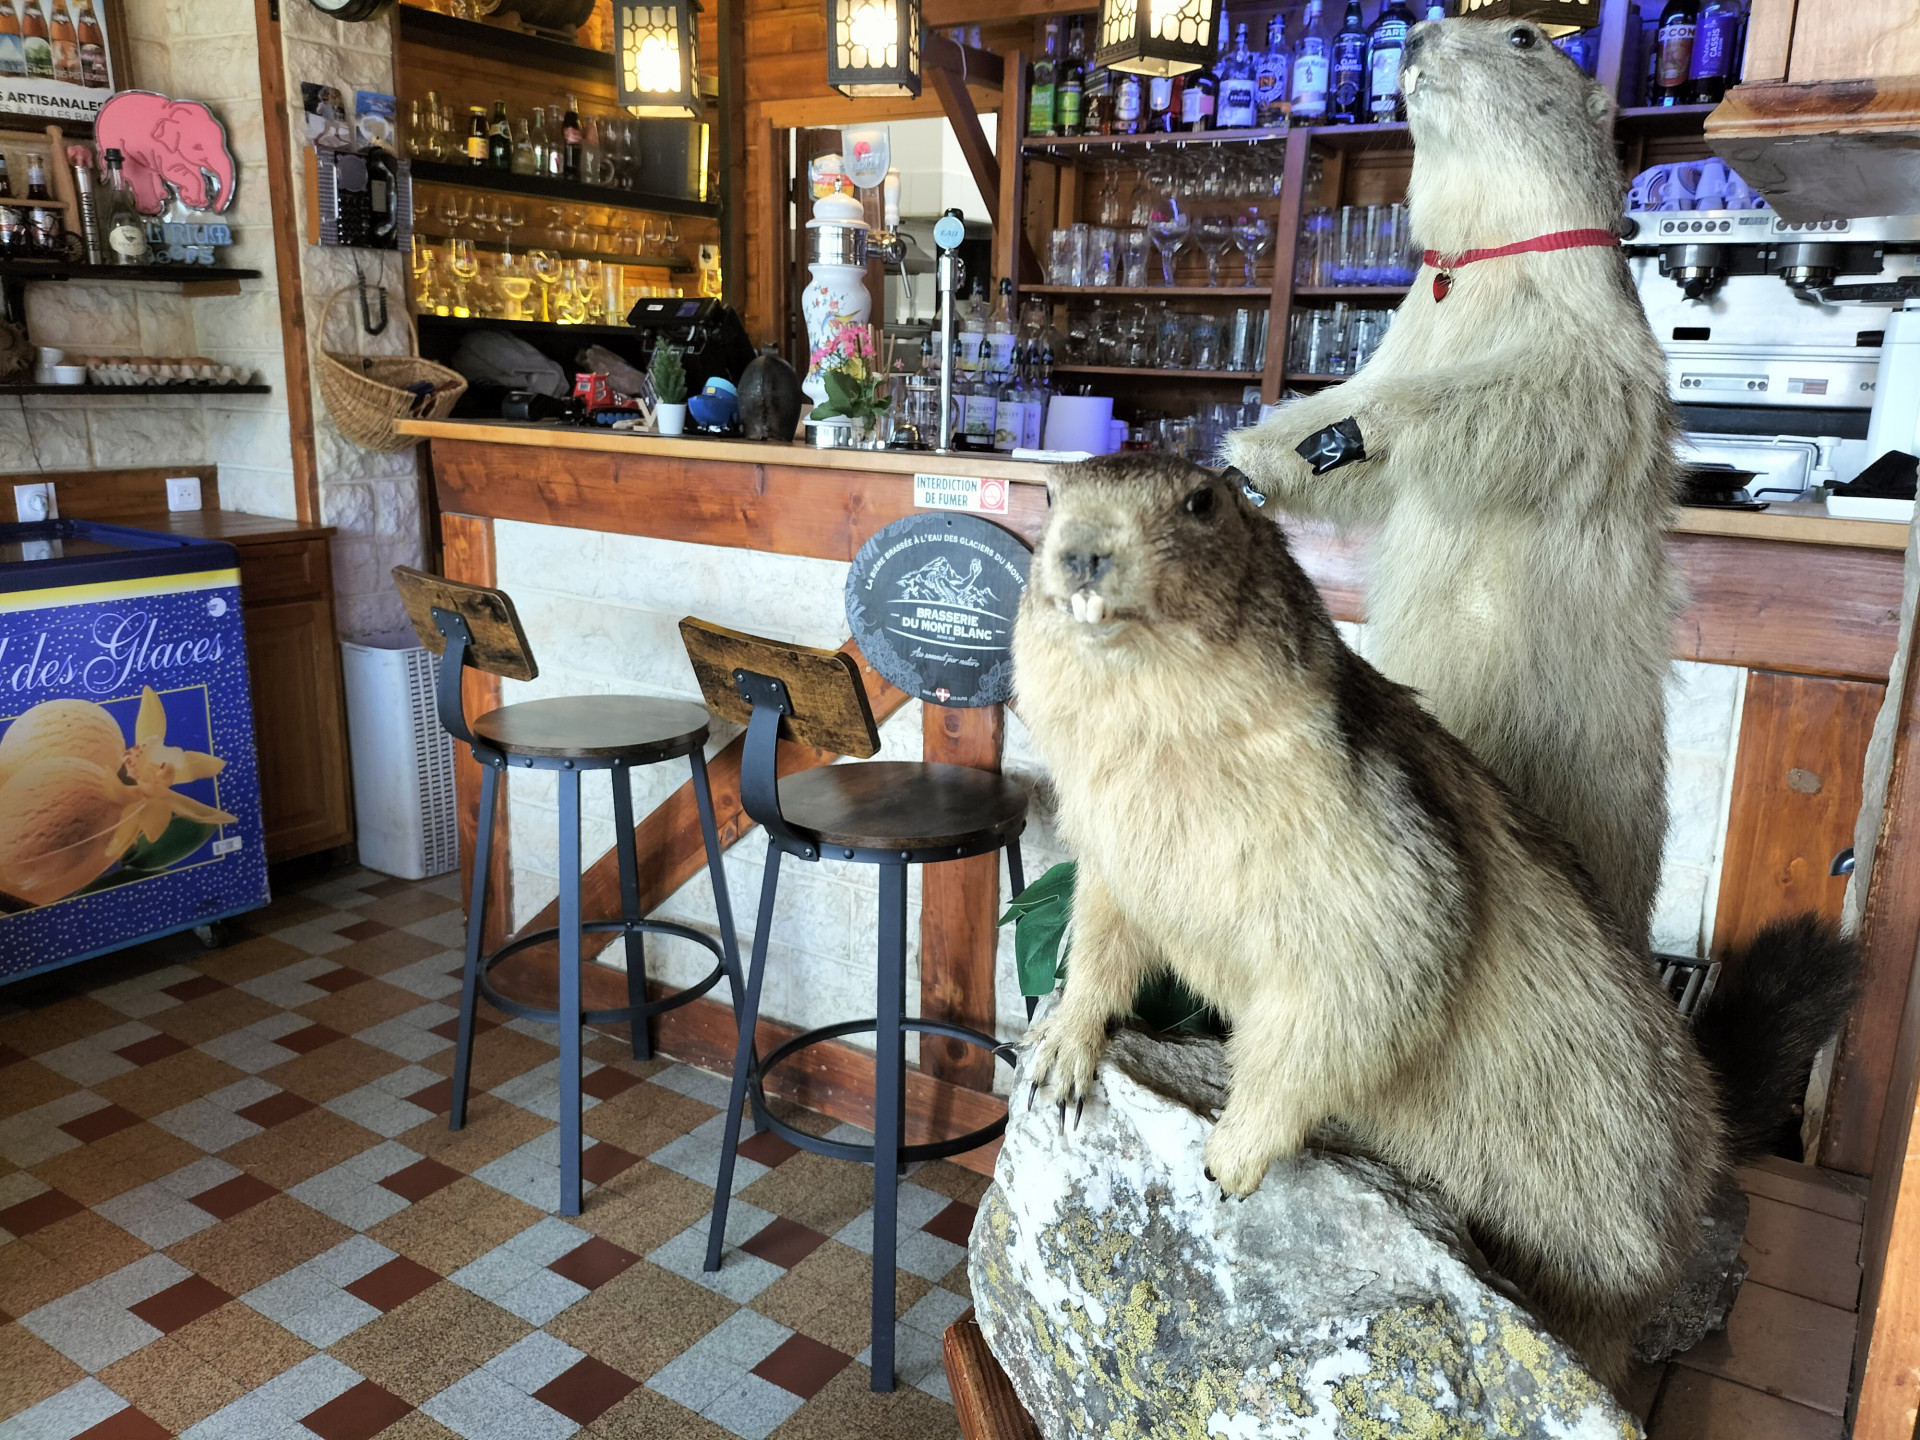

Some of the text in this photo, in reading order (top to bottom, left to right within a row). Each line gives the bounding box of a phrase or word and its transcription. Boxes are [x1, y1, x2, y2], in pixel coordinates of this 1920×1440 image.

[1374, 28, 1406, 39] RICARD
[1660, 27, 1696, 39] PCON
[1709, 28, 1720, 57] CASSIS
[8, 91, 105, 112] ARTISANALES
[940, 229, 958, 237] EAU
[917, 476, 978, 492] INTERDICTION
[925, 491, 968, 507] DE FUMER
[865, 533, 1025, 590] LA BIÈRE BRASSÉE À L'EAU DES GLACIERS DU MONT
[916, 607, 979, 627] BRASSERIE
[902, 616, 993, 641] DU MONT BLANC
[11, 632, 79, 692] des
[83, 611, 226, 694] Glaces
